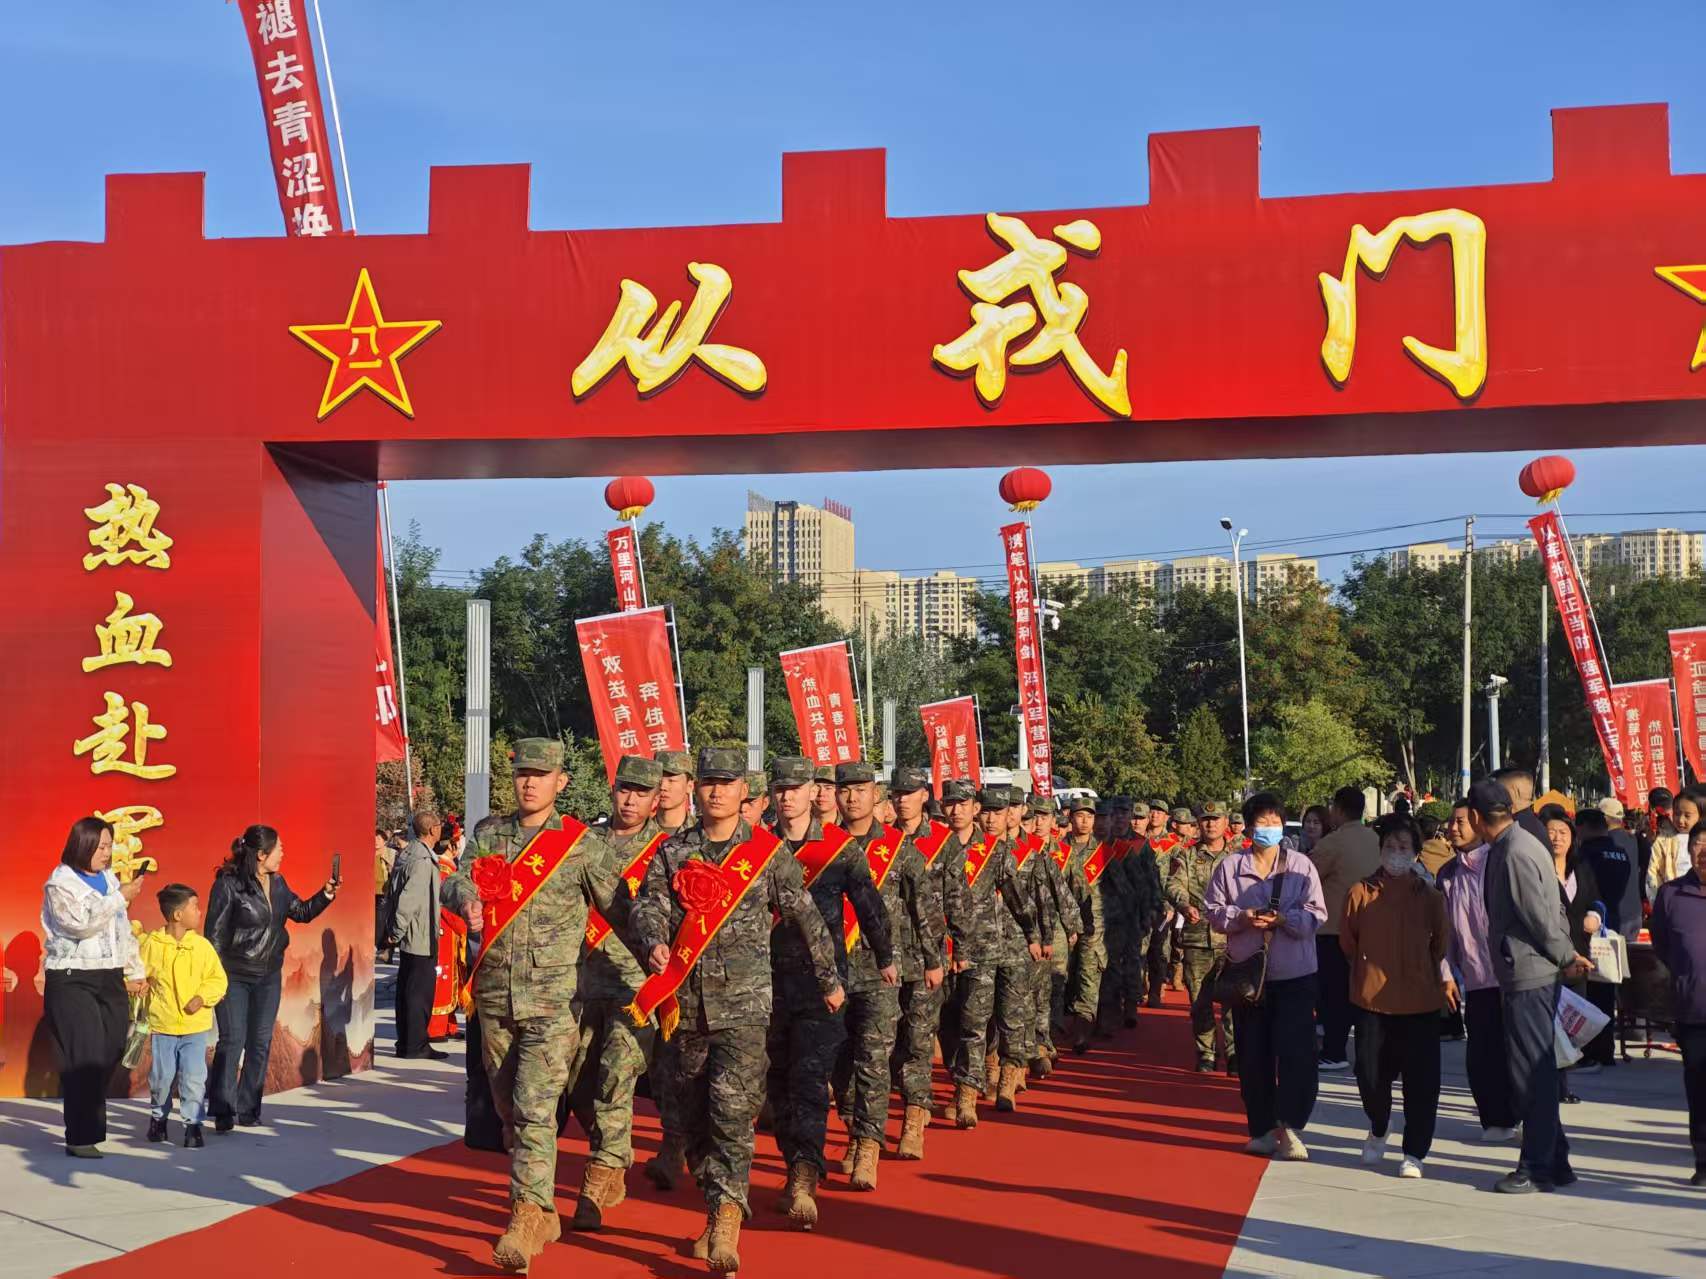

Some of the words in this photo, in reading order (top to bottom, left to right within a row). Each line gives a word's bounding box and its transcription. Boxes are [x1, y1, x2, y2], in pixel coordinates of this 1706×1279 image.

[256, 0, 333, 236] 褪去青涩换
[73, 483, 176, 932] 热血赴军
